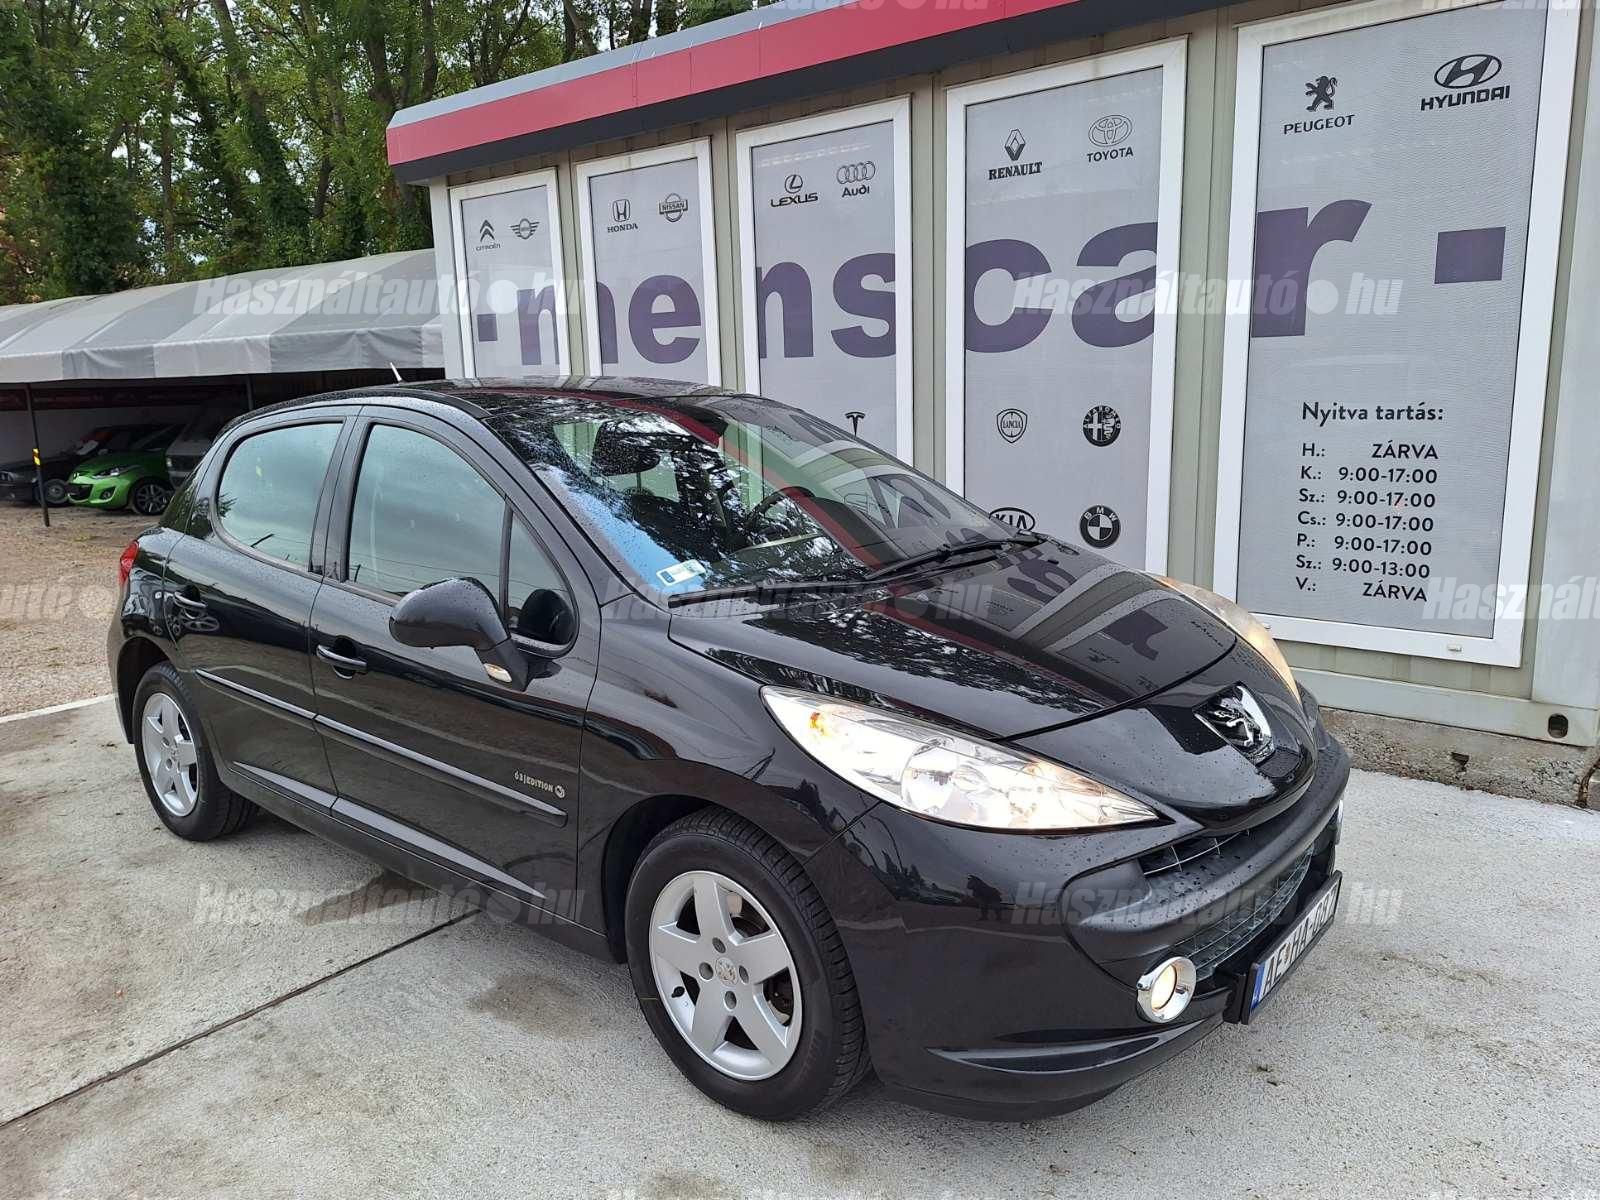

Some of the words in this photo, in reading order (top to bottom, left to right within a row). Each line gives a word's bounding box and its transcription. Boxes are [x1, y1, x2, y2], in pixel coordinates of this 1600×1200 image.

[1420, 85, 1511, 111] HYUNDAI
[1283, 115, 1355, 134] PEUGEOT
[1087, 147, 1133, 162] TOYOTA
[988, 161, 1043, 180] RENAULT
[771, 193, 818, 207] LEXUS
[842, 184, 869, 198] Audi
[662, 202, 684, 211] NISSAN
[607, 223, 638, 233] HONDA
[1302, 402, 1368, 427] Nyitva
[1376, 402, 1444, 420] tartás:
[1302, 443, 1326, 457] H.:
[1371, 440, 1439, 459] ZÁRVA
[1301, 466, 1322, 480] K.:
[1338, 467, 1438, 484] 9:00-17:00
[1299, 489, 1326, 503] Sz.:
[1337, 490, 1436, 508] 9:00-17:00
[1297, 511, 1327, 526] Cs.:
[1335, 513, 1434, 532] 9:00-17:00
[1297, 533, 1316, 548] P.:
[1334, 536, 1432, 556] 9:00-17:00
[1296, 554, 1322, 570] Sz.:
[1332, 558, 1430, 579] 9:00-13:00
[1296, 576, 1317, 592] V.:
[1362, 580, 1428, 602] ZÁRVA
